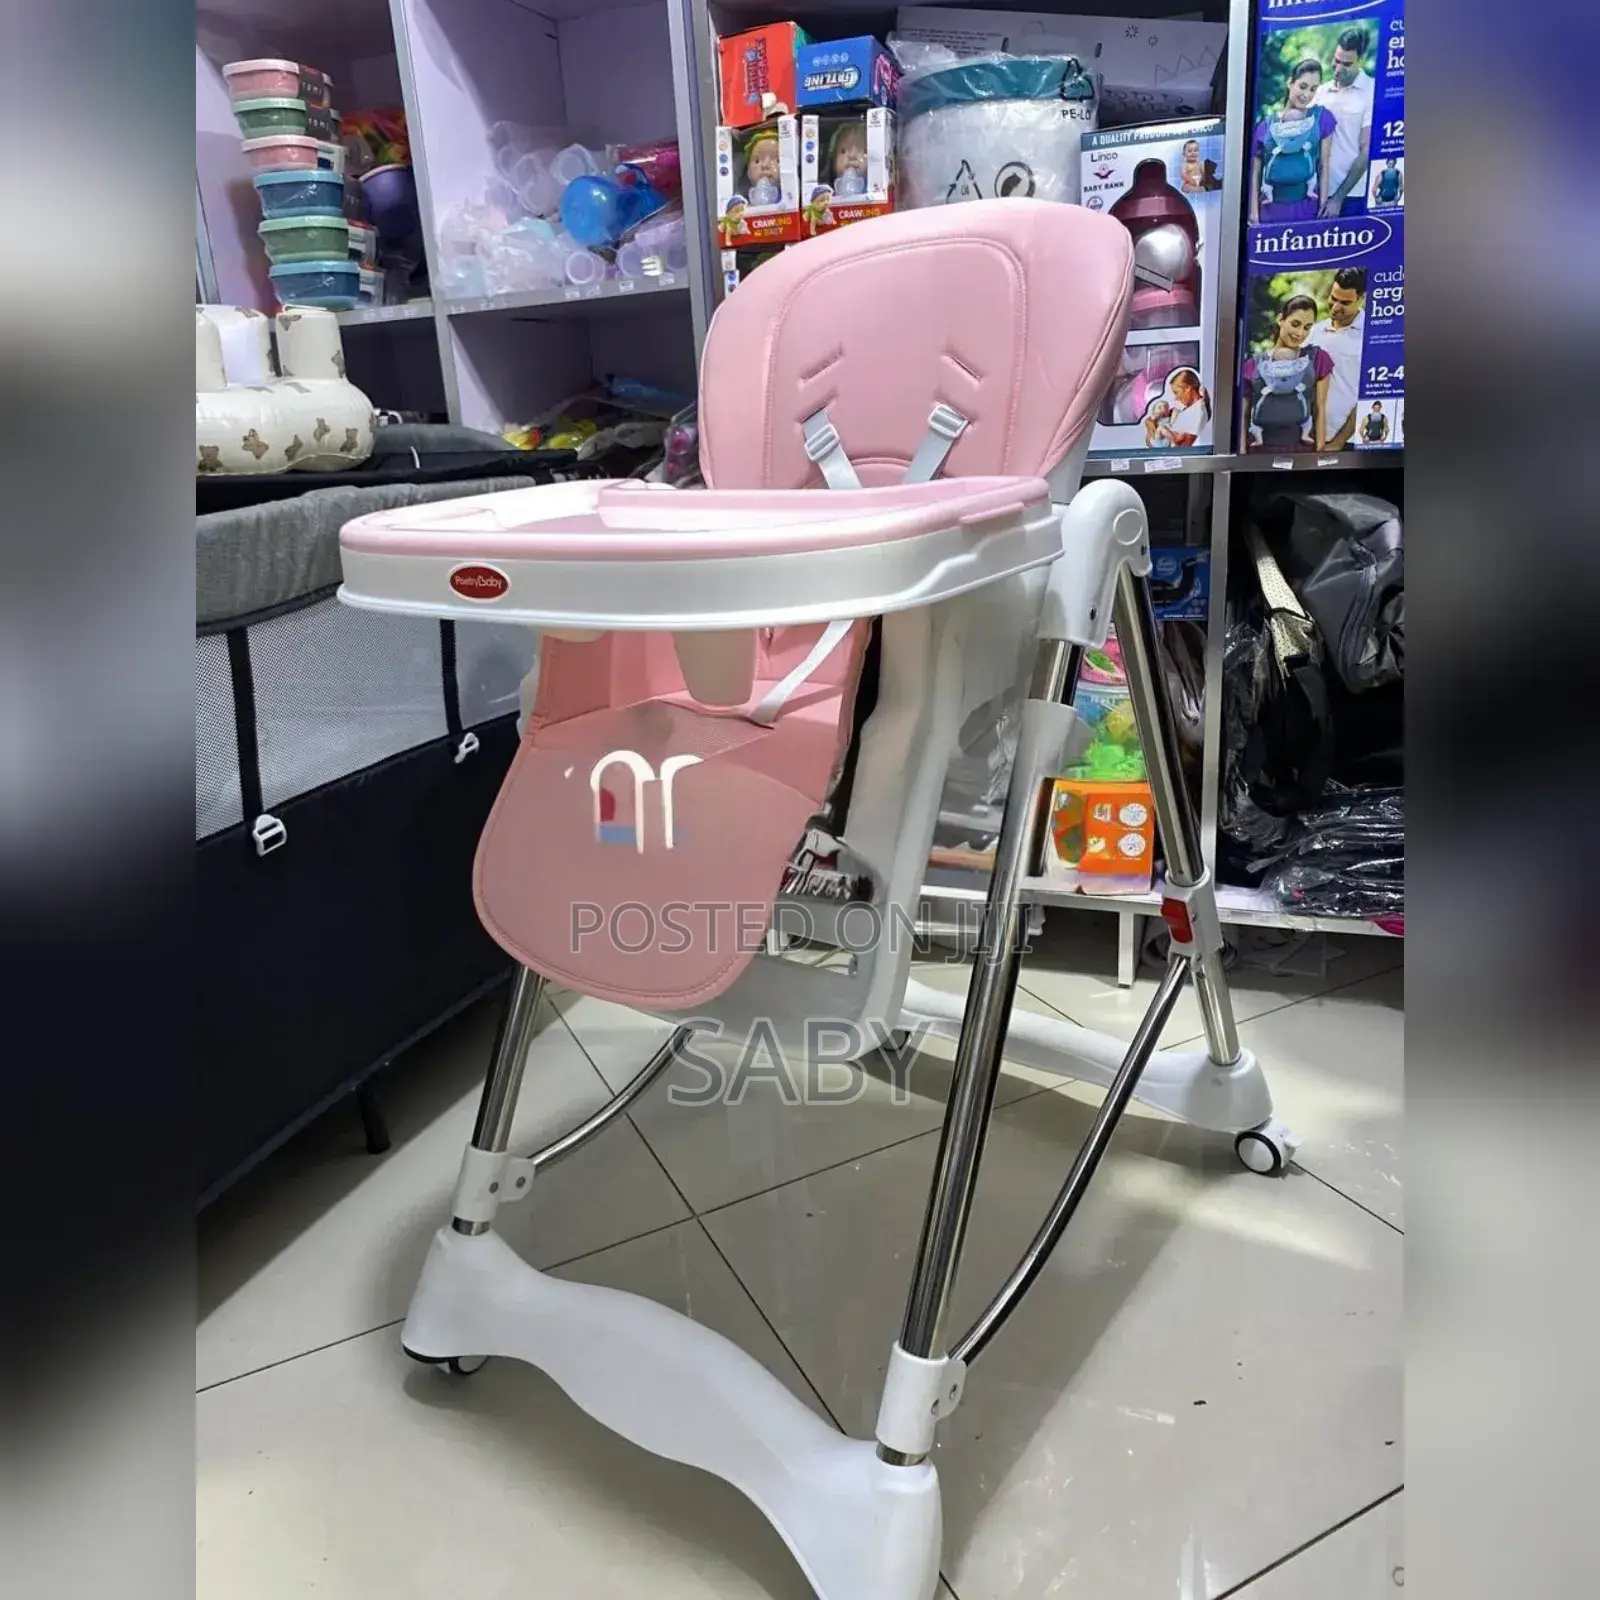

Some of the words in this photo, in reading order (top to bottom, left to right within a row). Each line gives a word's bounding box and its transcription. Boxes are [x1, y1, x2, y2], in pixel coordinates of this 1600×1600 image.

[1091, 136, 1098, 146] A
[1099, 131, 1132, 144] QUALITY
[1090, 152, 1118, 162] Linco
[1083, 184, 1102, 192] BABY
[1104, 181, 1125, 190] BANK
[838, 208, 881, 220] CRAWLING
[752, 217, 792, 229] CRAWLING
[1254, 226, 1374, 254] infantino
[1374, 265, 1404, 283] cud
[1372, 286, 1404, 302] erg
